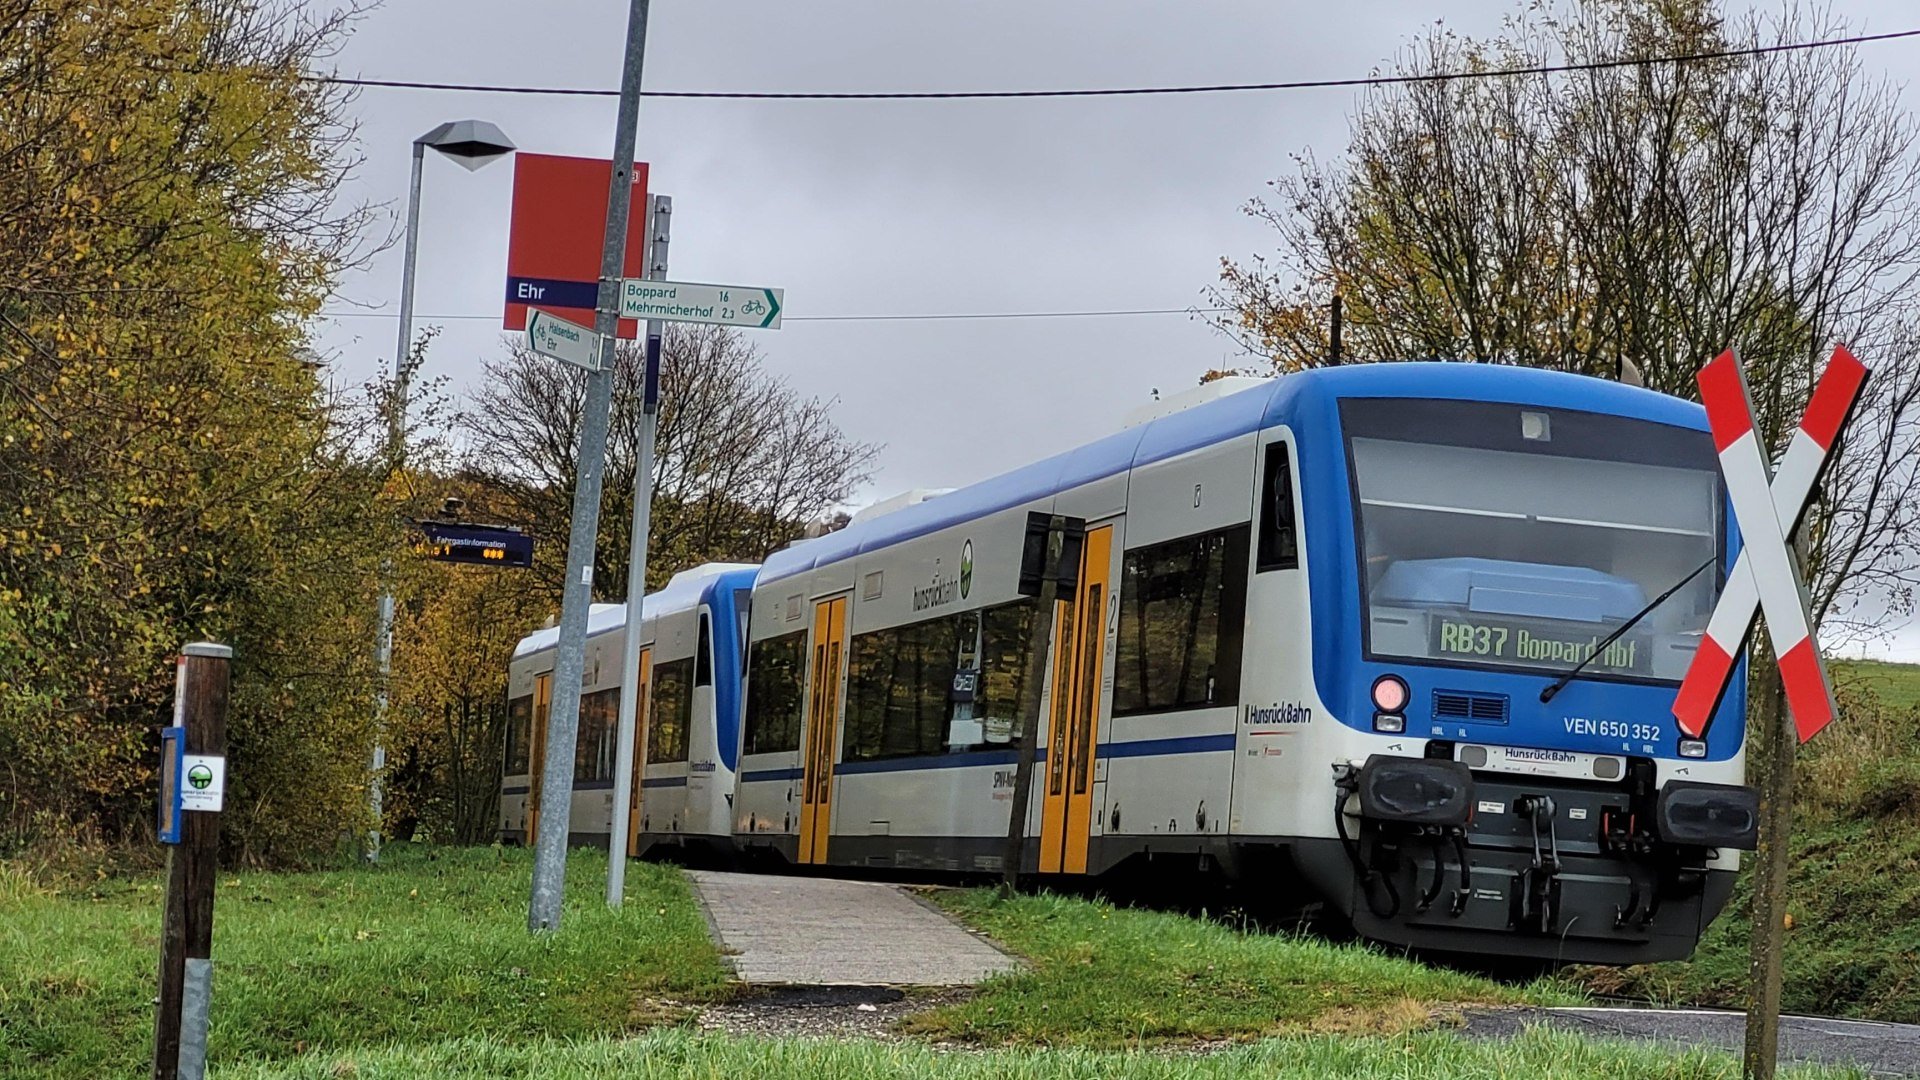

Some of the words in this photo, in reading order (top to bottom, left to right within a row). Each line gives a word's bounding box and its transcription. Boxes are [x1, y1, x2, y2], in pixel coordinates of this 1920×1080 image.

[518, 282, 545, 299] Ehr
[627, 284, 676, 299] Boppard
[719, 291, 729, 302] 16
[626, 301, 714, 317] Mehrmicherhof
[548, 321, 580, 342] Halsenbach
[436, 536, 506, 548] Fahrgastinformation
[1109, 594, 1117, 634] 2
[1440, 621, 1508, 656] RB37
[1516, 629, 1598, 664] Boppard
[1250, 701, 1312, 724] HunsrückBahn
[1563, 717, 1597, 735] VEN
[1599, 721, 1629, 738] 650
[1631, 724, 1660, 741] 352
[1505, 747, 1576, 763] HunsrückBahn
